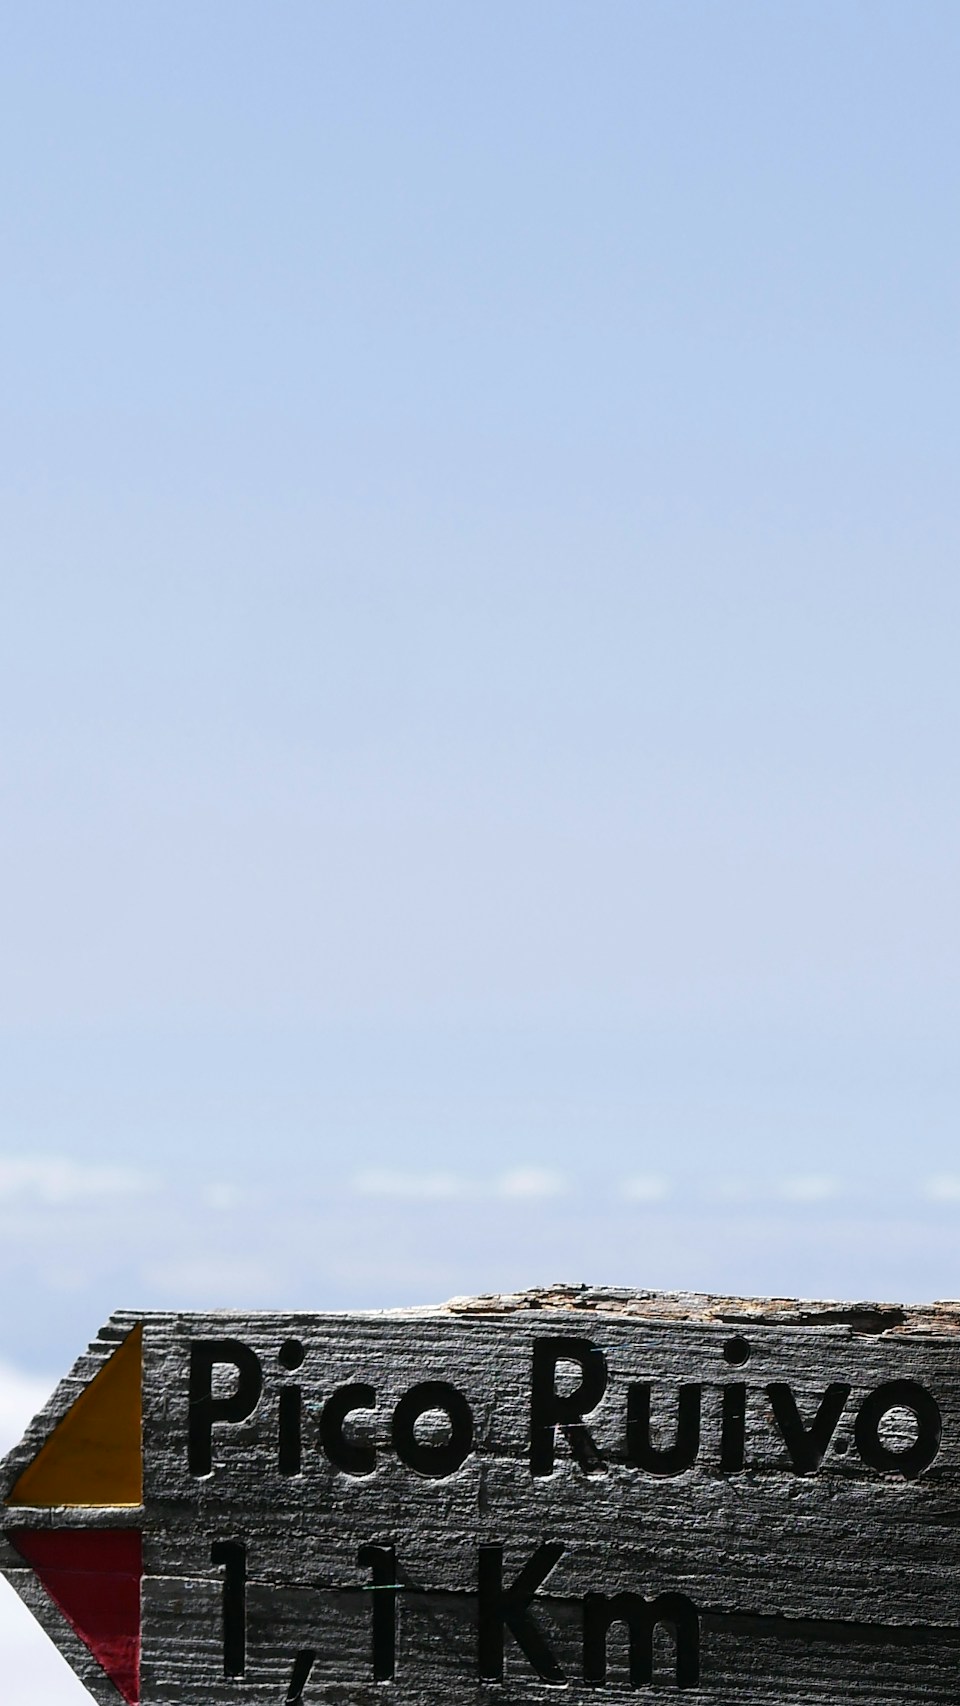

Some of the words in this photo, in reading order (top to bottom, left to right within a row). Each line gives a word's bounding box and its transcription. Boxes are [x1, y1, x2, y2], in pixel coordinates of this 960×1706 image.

[188, 1338, 474, 1477] Pico
[530, 1337, 942, 1478] Ruivo
[477, 1542, 700, 1688] Km
